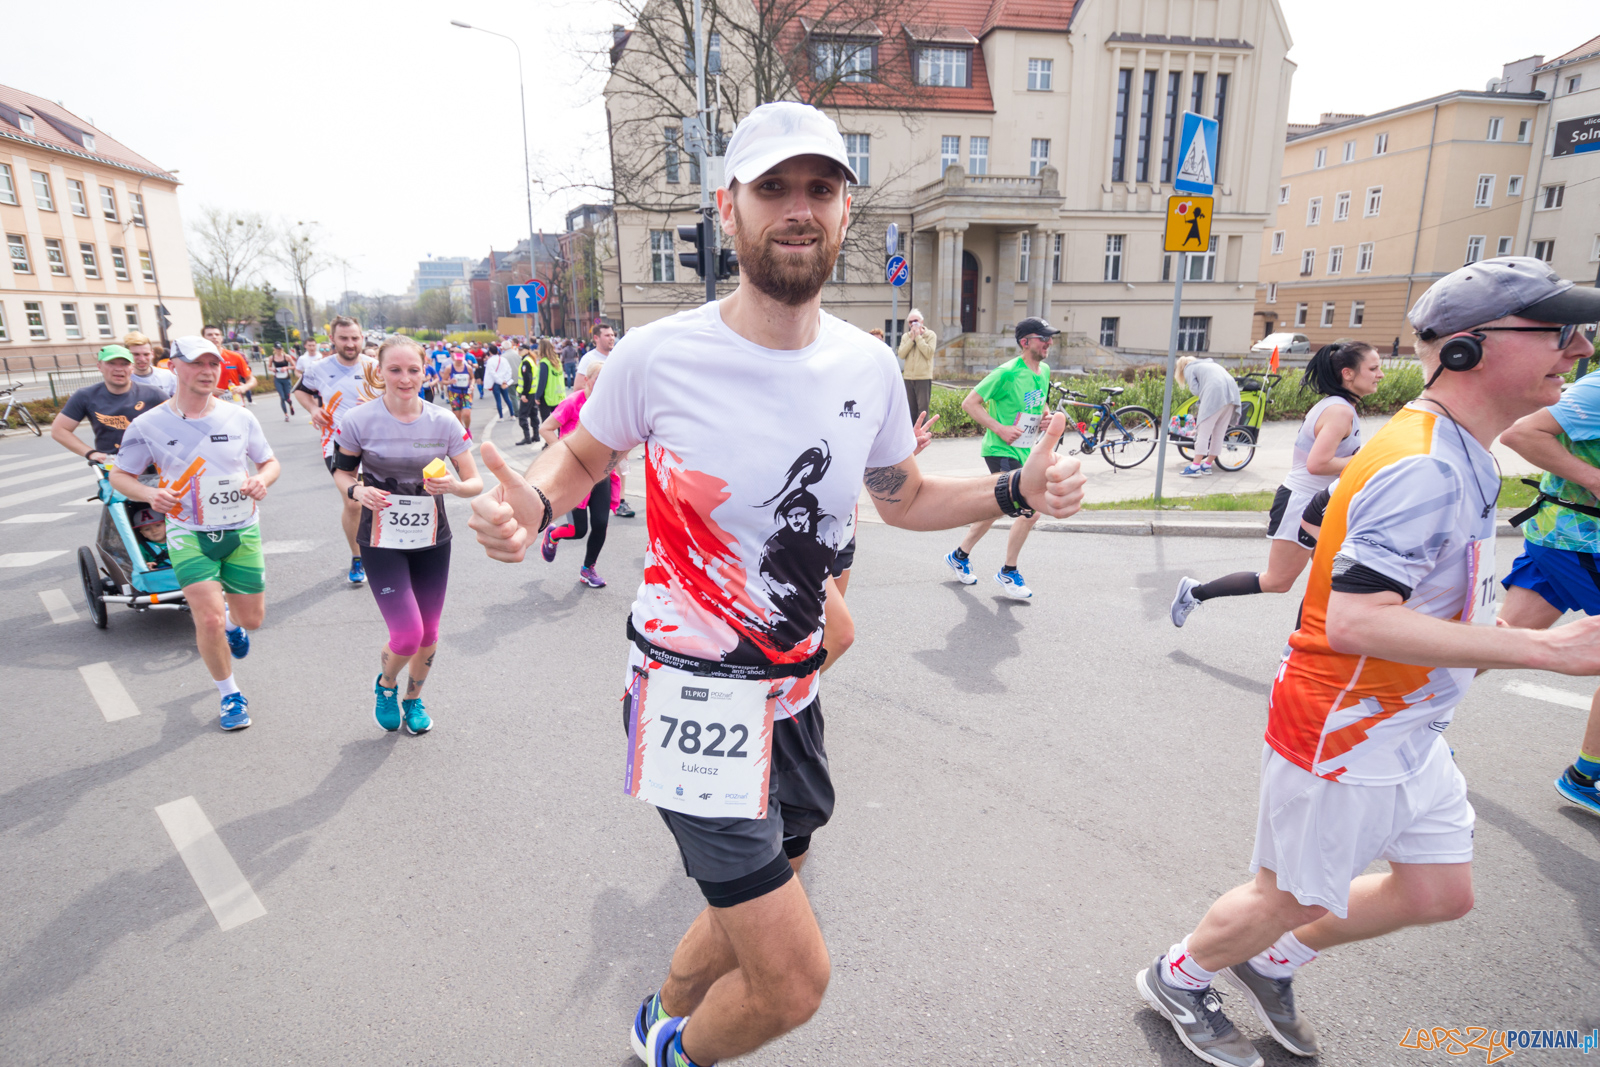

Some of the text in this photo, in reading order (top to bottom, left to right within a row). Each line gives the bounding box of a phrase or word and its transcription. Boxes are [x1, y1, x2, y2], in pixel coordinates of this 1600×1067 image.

[389, 512, 430, 526] 3623
[650, 648, 700, 667] performance
[655, 655, 684, 669] recovery
[660, 714, 749, 758] 7822
[681, 761, 719, 776] Łukasz
